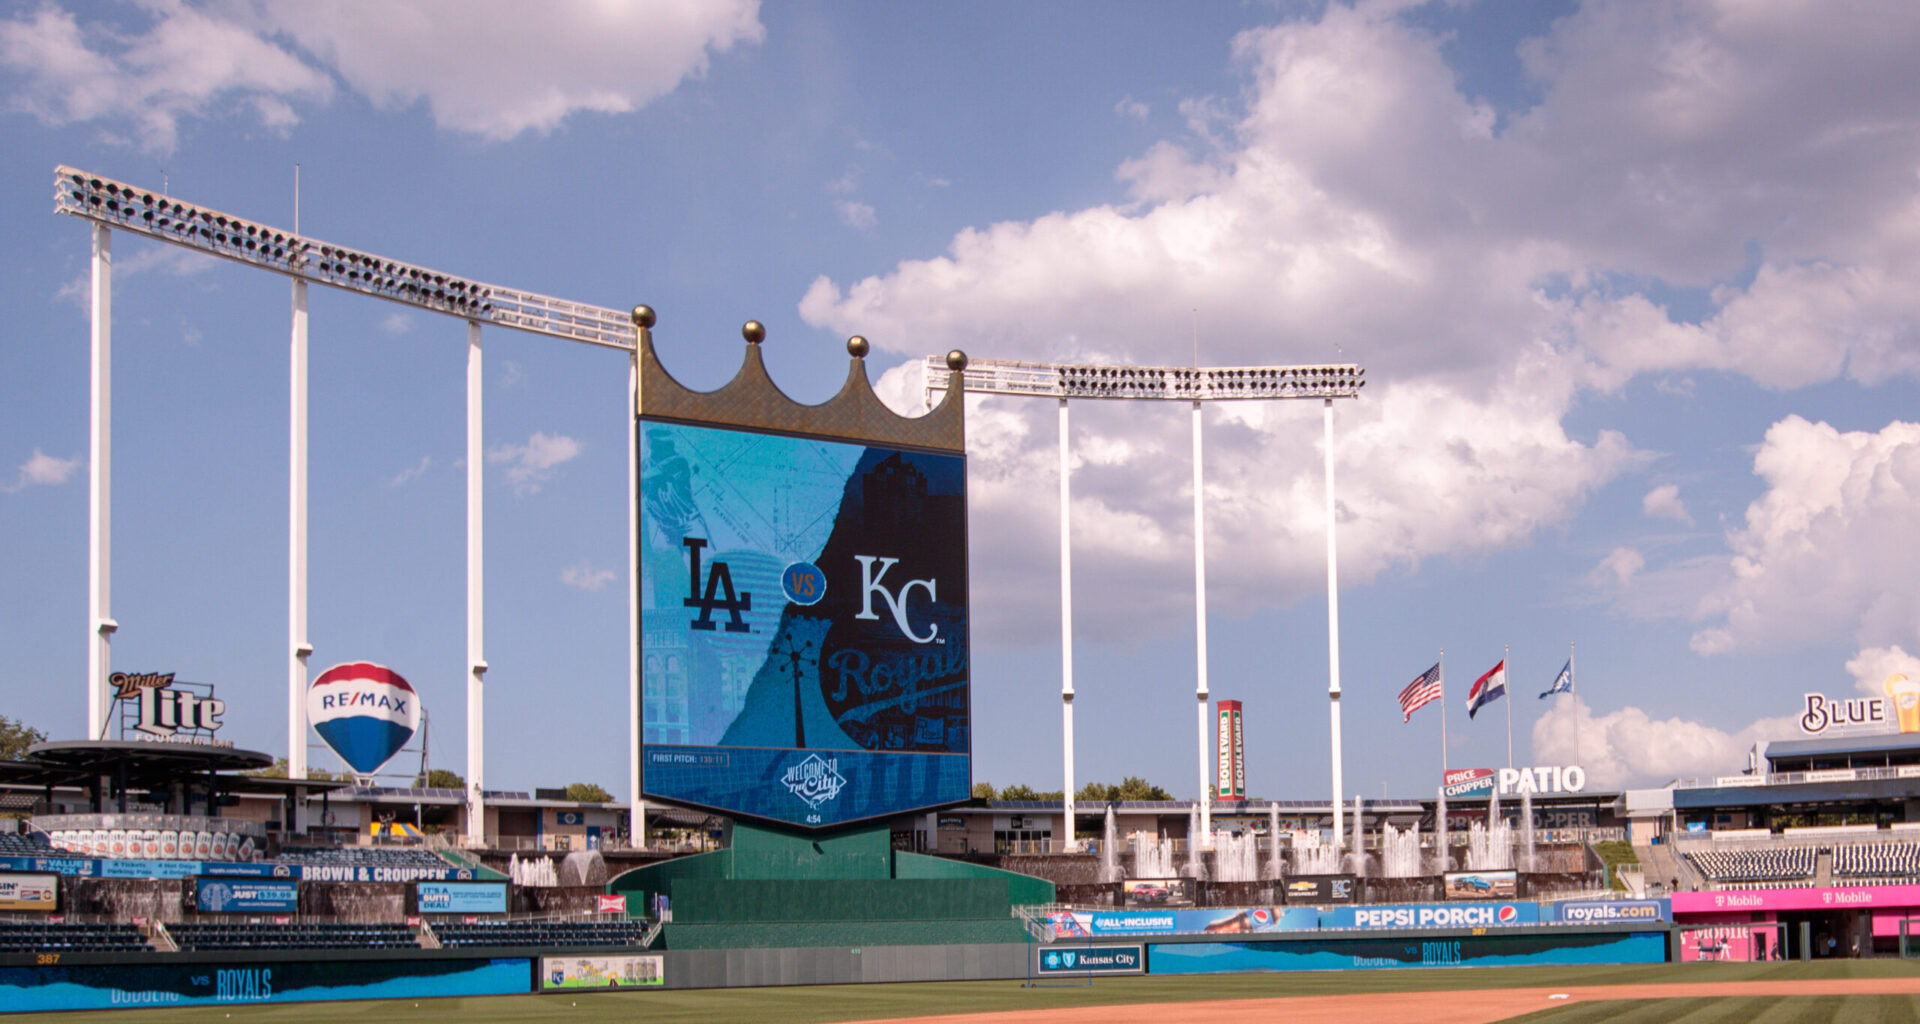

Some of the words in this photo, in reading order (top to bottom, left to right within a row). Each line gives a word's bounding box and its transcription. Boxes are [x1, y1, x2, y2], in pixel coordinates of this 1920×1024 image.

[683, 536, 751, 633] LA
[791, 571, 815, 597] VS
[853, 554, 937, 644] KC
[109, 671, 176, 698] Miller
[133, 685, 226, 736] Lite
[322, 691, 406, 715] RE/MAX
[1801, 694, 1884, 733] BLUE
[653, 753, 672, 763] FIRST
[673, 754, 697, 764] PITCH:
[1220, 716, 1229, 788] BOULEVARD
[788, 761, 825, 782] WELCOME
[828, 758, 838, 775] TO
[1446, 769, 1476, 785] PRICE
[1499, 765, 1586, 794] PATIO
[803, 773, 841, 800] City
[1445, 777, 1493, 797] CHOPPER
[806, 814, 821, 823] 4:54
[48, 858, 84, 868] VALUE
[302, 866, 354, 881] BROWN
[358, 867, 370, 881] &
[232, 890, 257, 899] JUST
[423, 894, 450, 902] SUITE
[1726, 895, 1763, 906] Mobile
[1834, 891, 1872, 904] Mobile
[1103, 916, 1174, 927] ALL-INCLUSIVE
[1355, 906, 1415, 926] PEPSI
[1419, 905, 1494, 926] PORCH
[1567, 903, 1656, 920] royals.com
[37, 953, 60, 966] 387
[1079, 954, 1113, 966] Kansas
[1115, 954, 1136, 966] City
[1422, 940, 1461, 966] ROYALS
[216, 968, 272, 1001] ROYALS
